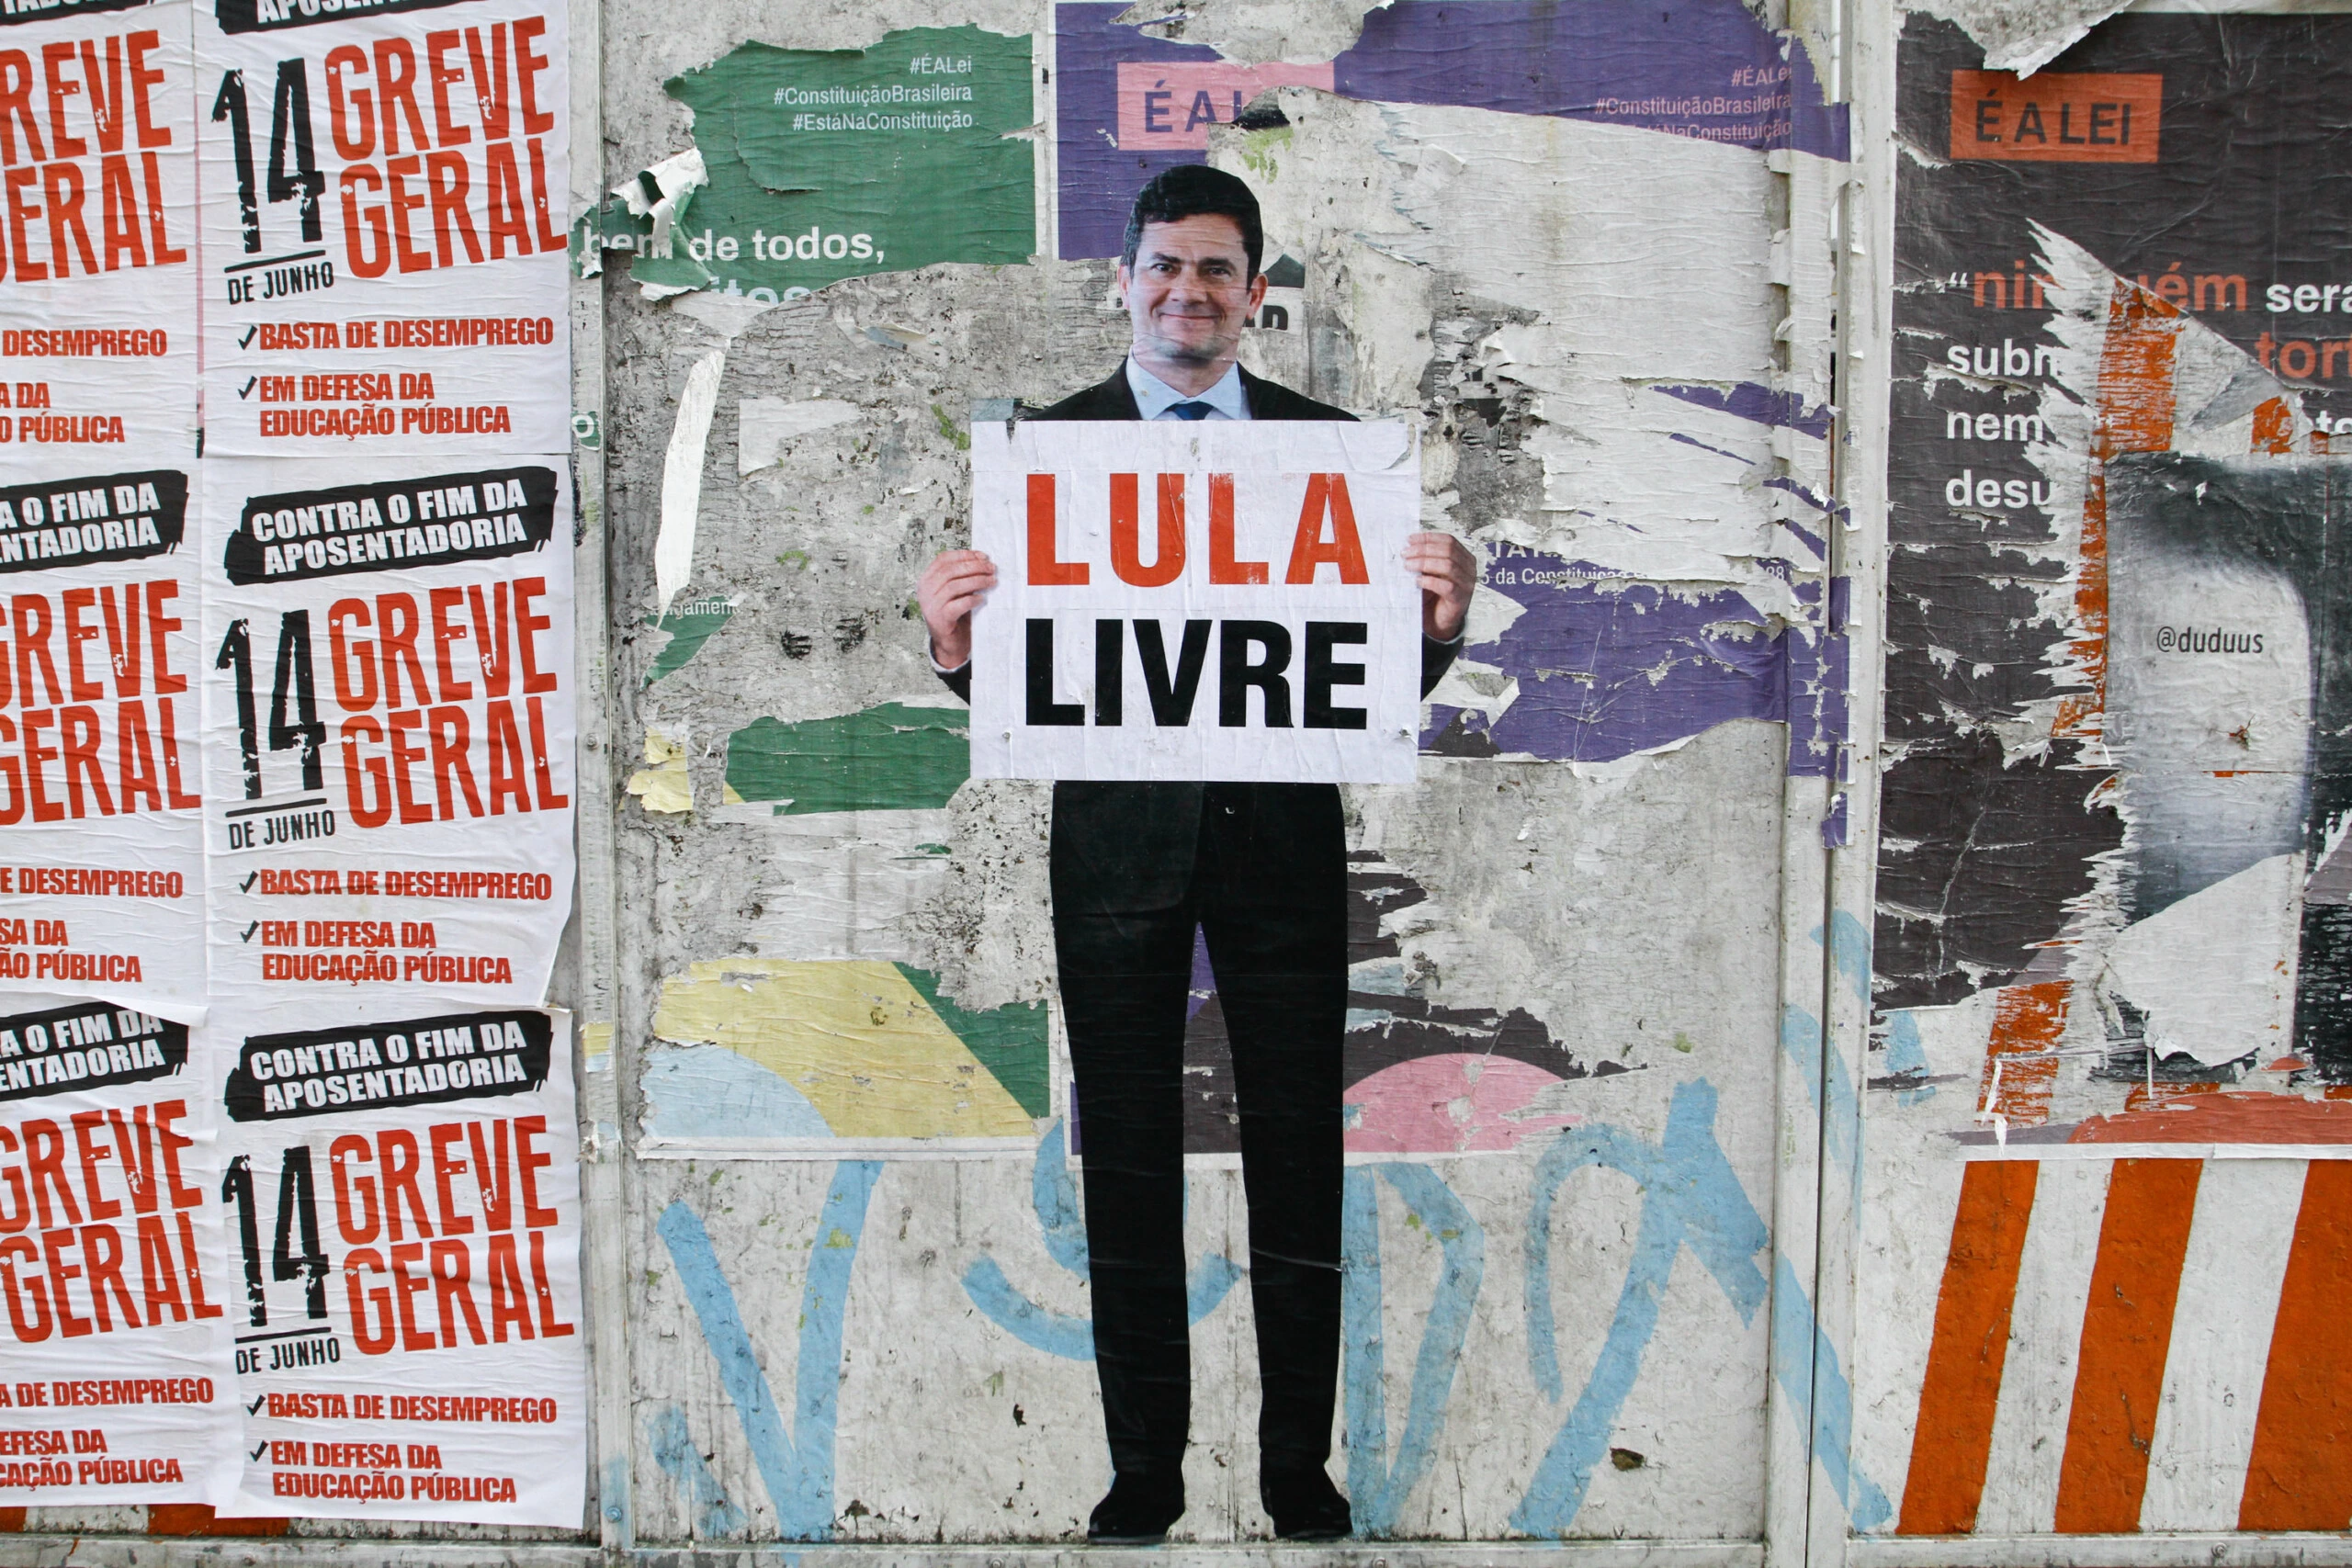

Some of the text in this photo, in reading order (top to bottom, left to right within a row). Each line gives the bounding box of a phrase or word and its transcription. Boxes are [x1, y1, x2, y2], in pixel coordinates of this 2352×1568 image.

[910, 53, 973, 75] #ÉALei
[325, 17, 553, 160] GREVE
[774, 84, 973, 107] #ConstituiçãoBrasileira
[1145, 79, 1172, 132] É
[1596, 92, 1792, 118] #ConstituiçãoBrasileira
[792, 110, 973, 131] #EstáNaConstituição
[1976, 89, 2132, 146] É A LEI
[212, 59, 325, 253] 14
[0, 152, 187, 282] ERAL
[341, 138, 567, 277] GERAL
[690, 229, 739, 261] de
[752, 226, 885, 264] todos,
[229, 262, 334, 304] DE JUNHO
[4, 330, 166, 356] DESEMPREGO
[260, 318, 553, 349] BASTA DE DESEMPREGO
[17, 383, 50, 408] DA
[261, 374, 434, 401] EM DEFESA DA
[18, 410, 125, 443] PÚBLICA
[259, 400, 512, 442] EDUCAÇÃO PÚBLICA
[1947, 412, 2043, 441] nem
[22, 495, 46, 525] O
[51, 487, 109, 523] FIM
[116, 480, 160, 513] DA
[251, 479, 529, 543] CONTRA O FIM DA
[264, 512, 529, 575] APOSENTADORIA
[1026, 473, 1370, 587] LULA
[329, 577, 557, 712] GREVE
[2156, 626, 2264, 653] @duduus
[1025, 618, 1368, 730] LIVRE
[216, 610, 326, 799] 14
[341, 697, 568, 828] GERAL
[229, 810, 334, 849] DE JUNHO
[19, 868, 182, 897] DESEMPREGO
[261, 870, 551, 899] BASTA DE DESEMPREGO
[35, 920, 68, 945] DA
[263, 921, 435, 948] EM DEFESA DA
[36, 949, 142, 983] PÚBLICA
[262, 950, 514, 987] EDUCAÇÃO PÚBLICA
[25, 1024, 51, 1055] O
[53, 1013, 115, 1051] FIM
[117, 1009, 164, 1042] DA
[249, 1021, 529, 1081] CONTRA O FIM DA
[263, 1053, 528, 1113] APOSENTADORIA
[331, 1115, 558, 1245] GREVE
[222, 1146, 330, 1326] 14
[0, 1212, 222, 1342] GERAL
[344, 1231, 574, 1355] GERAL
[236, 1338, 339, 1374] DE JUNHO
[17, 1383, 48, 1406] DE
[53, 1378, 213, 1405] DESEMPREGO
[268, 1393, 556, 1422] BASTA DE DESEMPREGO
[73, 1430, 107, 1453] DA
[271, 1441, 441, 1468] EM DEFESA DA
[77, 1453, 184, 1484] PÚBLICA
[273, 1471, 516, 1505] EDUCAÇÃO PÚBLICA
